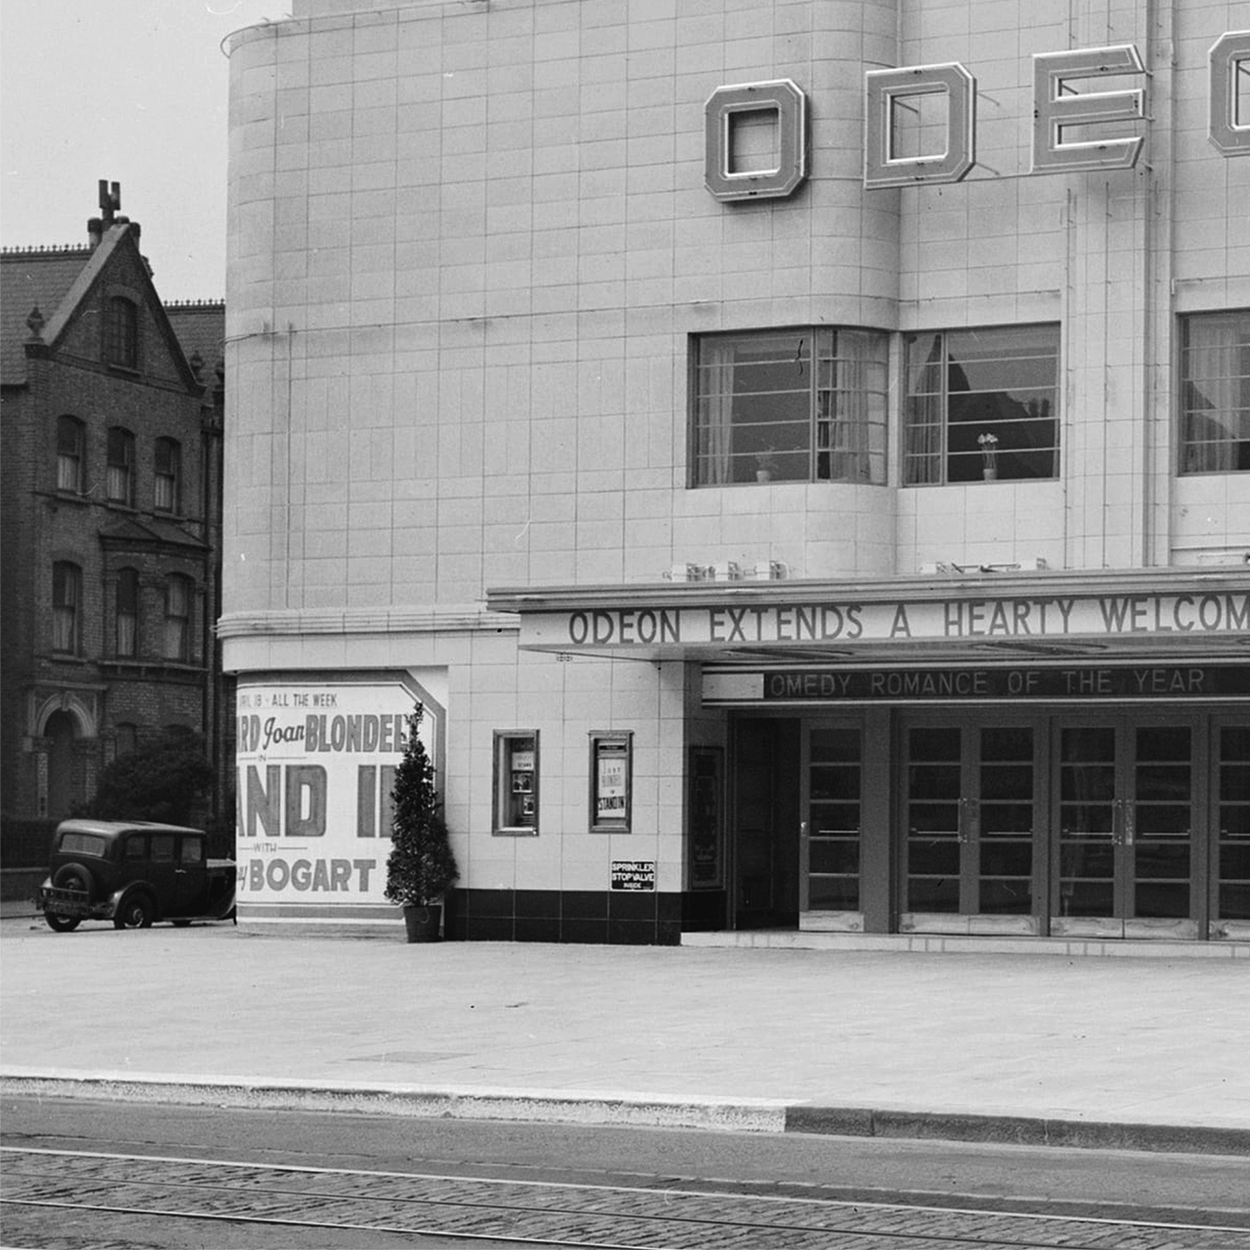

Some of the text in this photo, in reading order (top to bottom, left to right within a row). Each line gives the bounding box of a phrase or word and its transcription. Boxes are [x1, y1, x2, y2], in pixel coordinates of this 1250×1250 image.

[569, 609, 682, 646] ODEON
[709, 604, 864, 643] EXTENDS
[889, 602, 911, 639] A
[944, 598, 1076, 636] HEARTY
[871, 670, 988, 695] ROMANCE
[1007, 670, 1041, 694] OF
[1062, 669, 1112, 694] THE
[1134, 668, 1205, 692] YEAR
[271, 693, 289, 707] ALL
[293, 693, 309, 707] THE
[312, 693, 338, 707] WEEK
[263, 717, 304, 750] Joan
[253, 843, 277, 853] WITH
[249, 858, 376, 892] BOGART
[612, 863, 655, 872] SPRINKLER
